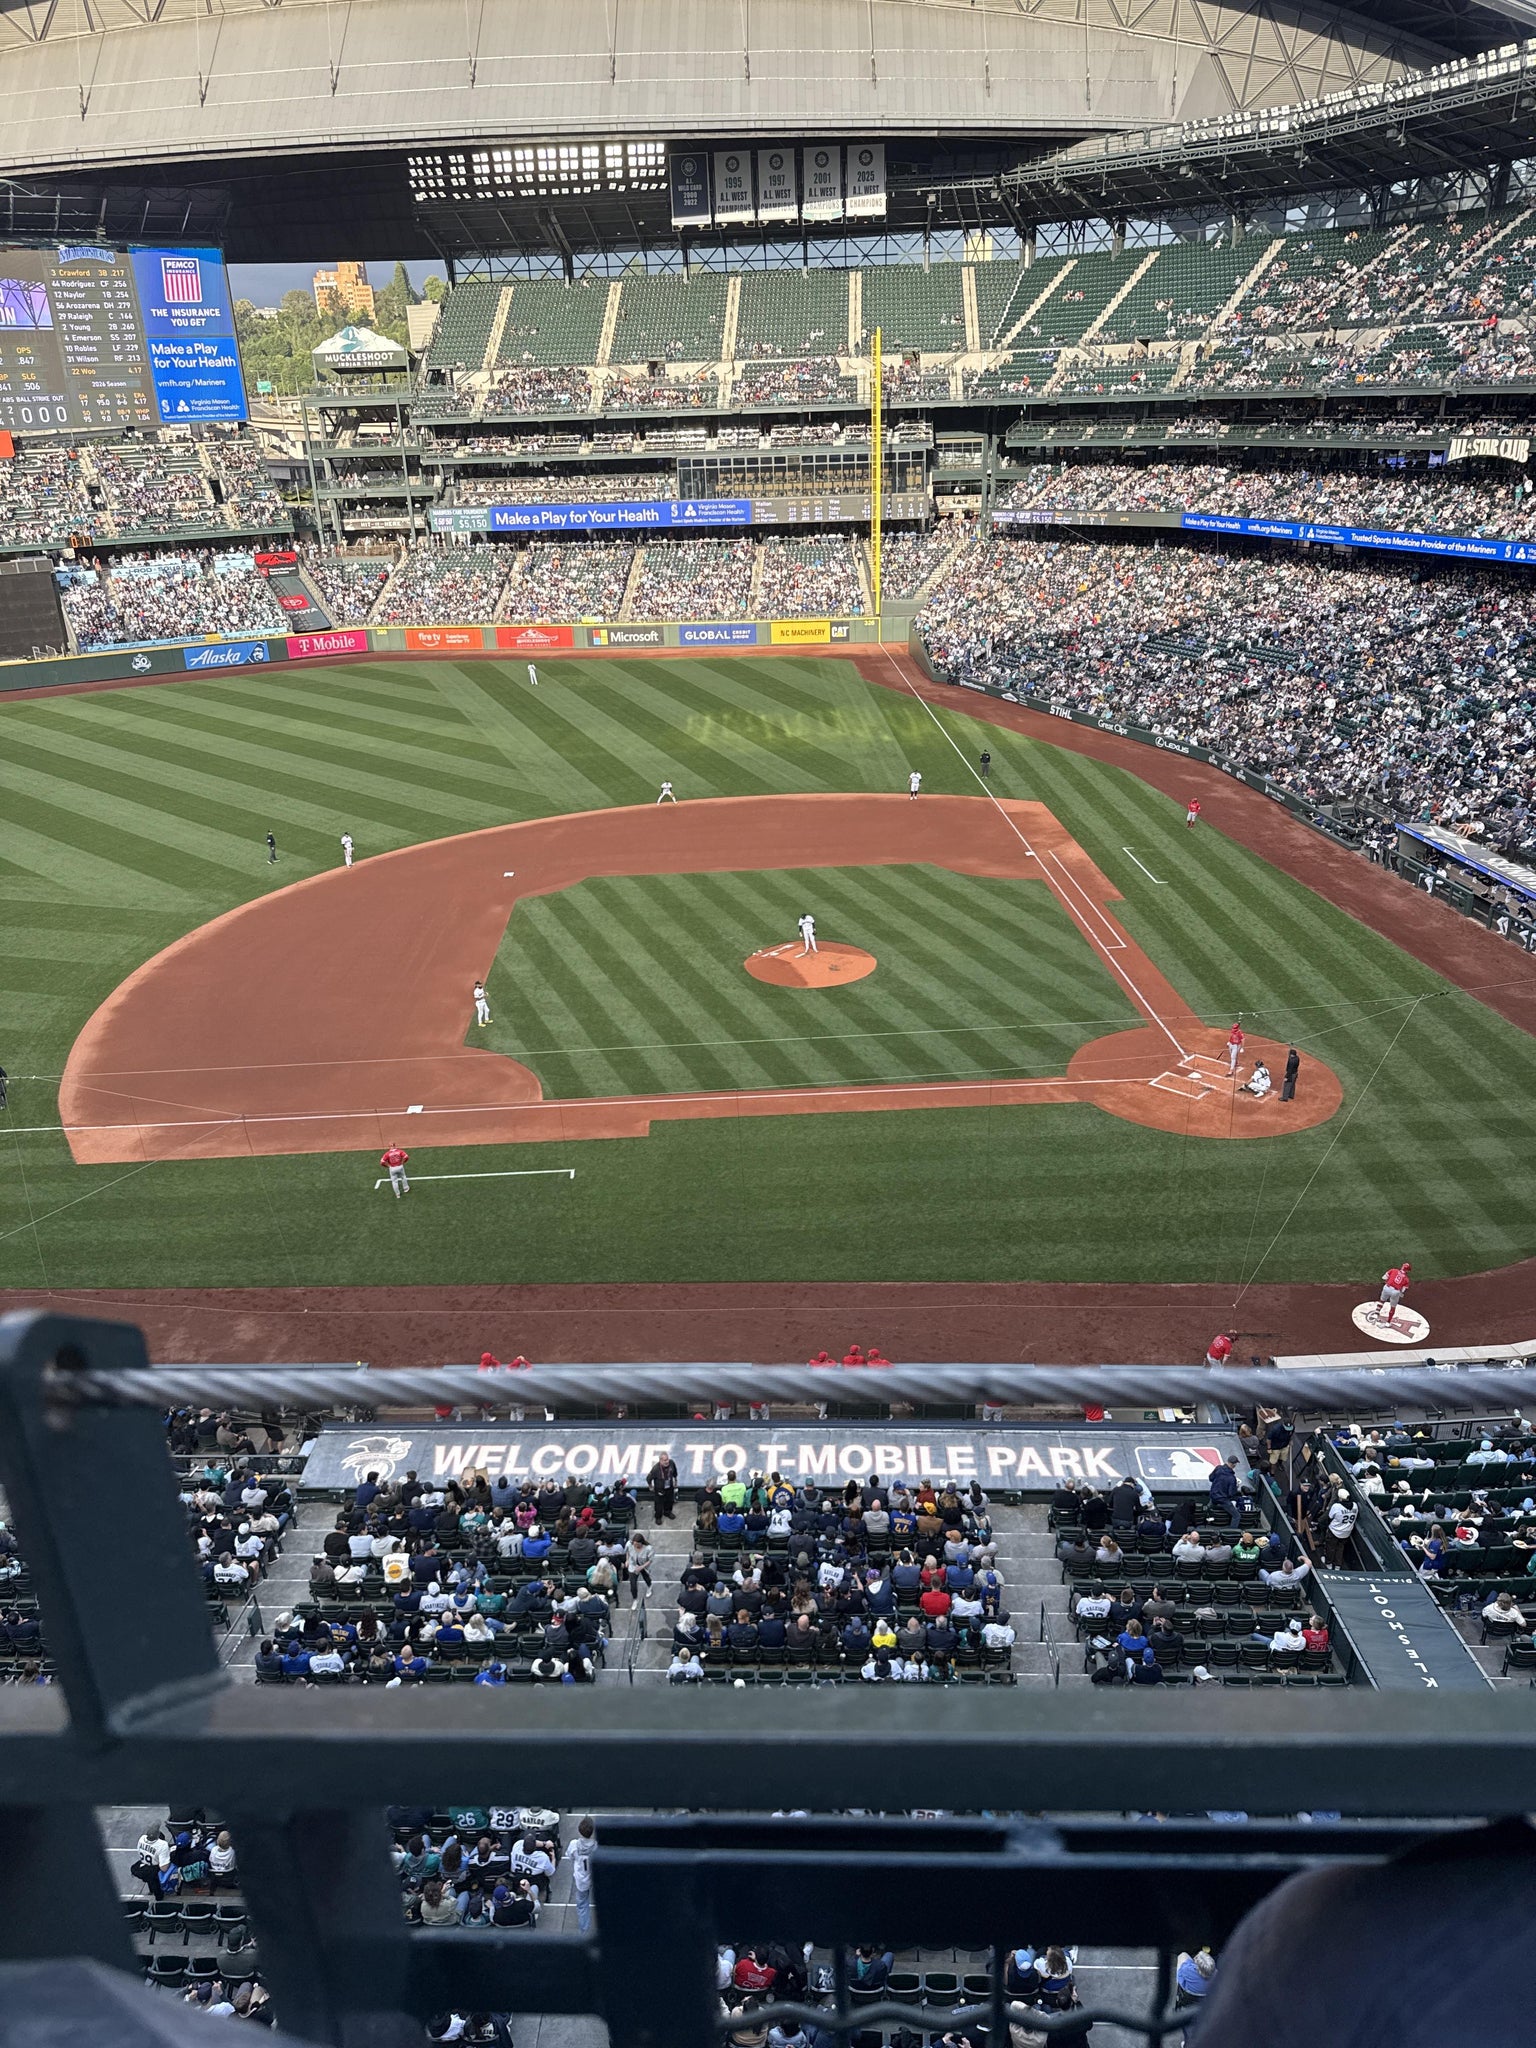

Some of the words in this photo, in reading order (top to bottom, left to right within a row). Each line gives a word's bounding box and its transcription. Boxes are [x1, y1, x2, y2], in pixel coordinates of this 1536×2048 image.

[769, 174, 785, 186] 1997
[814, 172, 831, 184] 2001
[857, 171, 874, 182] 2025
[724, 177, 742, 188] 1995
[775, 189, 791, 199] WEST
[820, 187, 836, 197] WEST
[864, 185, 879, 194] WEST
[731, 191, 747, 201] WEST
[718, 203, 751, 214] CHAMPIONS
[761, 202, 794, 212] CHAMPIONS
[806, 200, 839, 210] CHAMPIONS
[849, 198, 882, 208] CHAMPIONS
[61, 281, 95, 289] Rodriguez
[68, 313, 93, 321] Raleigh
[150, 308, 168, 317] THE
[171, 308, 220, 317] INSURANCE
[190, 318, 206, 326] GET
[151, 343, 184, 355] Make
[186, 346, 193, 354] a
[194, 343, 217, 356] Play
[18, 357, 34, 365] .847
[154, 357, 171, 368] for
[171, 357, 197, 368] Your
[199, 356, 236, 367] Health
[325, 352, 394, 362] MUCKLESHOOT
[24, 382, 40, 390] .506
[21, 407, 33, 424] 0
[38, 407, 50, 423] 0
[56, 406, 67, 422] 0
[1500, 439, 1530, 463] CLUB
[697, 503, 718, 511] Virginia
[495, 512, 530, 525] Make
[532, 515, 539, 524] a
[542, 511, 566, 527] Play
[570, 510, 587, 524] for
[588, 510, 616, 523] Your
[618, 508, 659, 522] Health
[1185, 518, 1196, 526] Make
[1200, 520, 1209, 529] Play
[1216, 521, 1226, 529] Your
[1226, 521, 1241, 530] Health
[1352, 533, 1373, 543] Trusted
[1373, 534, 1391, 546] Sports
[1392, 536, 1420, 547] Medicine
[1421, 539, 1446, 550] Provider
[1447, 541, 1455, 550] of
[1455, 543, 1465, 552] the
[1467, 543, 1497, 555] Mariners
[418, 632, 432, 641] fire
[433, 633, 440, 641] tv
[610, 631, 659, 642] Microsoft
[684, 628, 731, 641] GLOBAL
[791, 629, 826, 637] MACHINERY
[831, 626, 849, 638] CAT
[313, 635, 356, 651] Mobile
[136, 657, 147, 666] 50
[190, 648, 240, 666] Alaska
[1050, 704, 1072, 720] STIHL
[1097, 719, 1114, 732] Great
[1164, 741, 1189, 754] LEXUS
[434, 1444, 673, 1476] WELCOME
[685, 1443, 747, 1475] TO
[759, 1444, 978, 1476] T-MOBILE
[986, 1446, 1122, 1478] PARK
[772, 1516, 782, 1526] 44
[1342, 1514, 1356, 1524] 29
[894, 1523, 909, 1533] 44
[509, 1544, 519, 1555] 11
[1369, 1583, 1439, 1688] KLESHOOT
[457, 1812, 476, 1827] 26
[496, 1813, 514, 1828] 29
